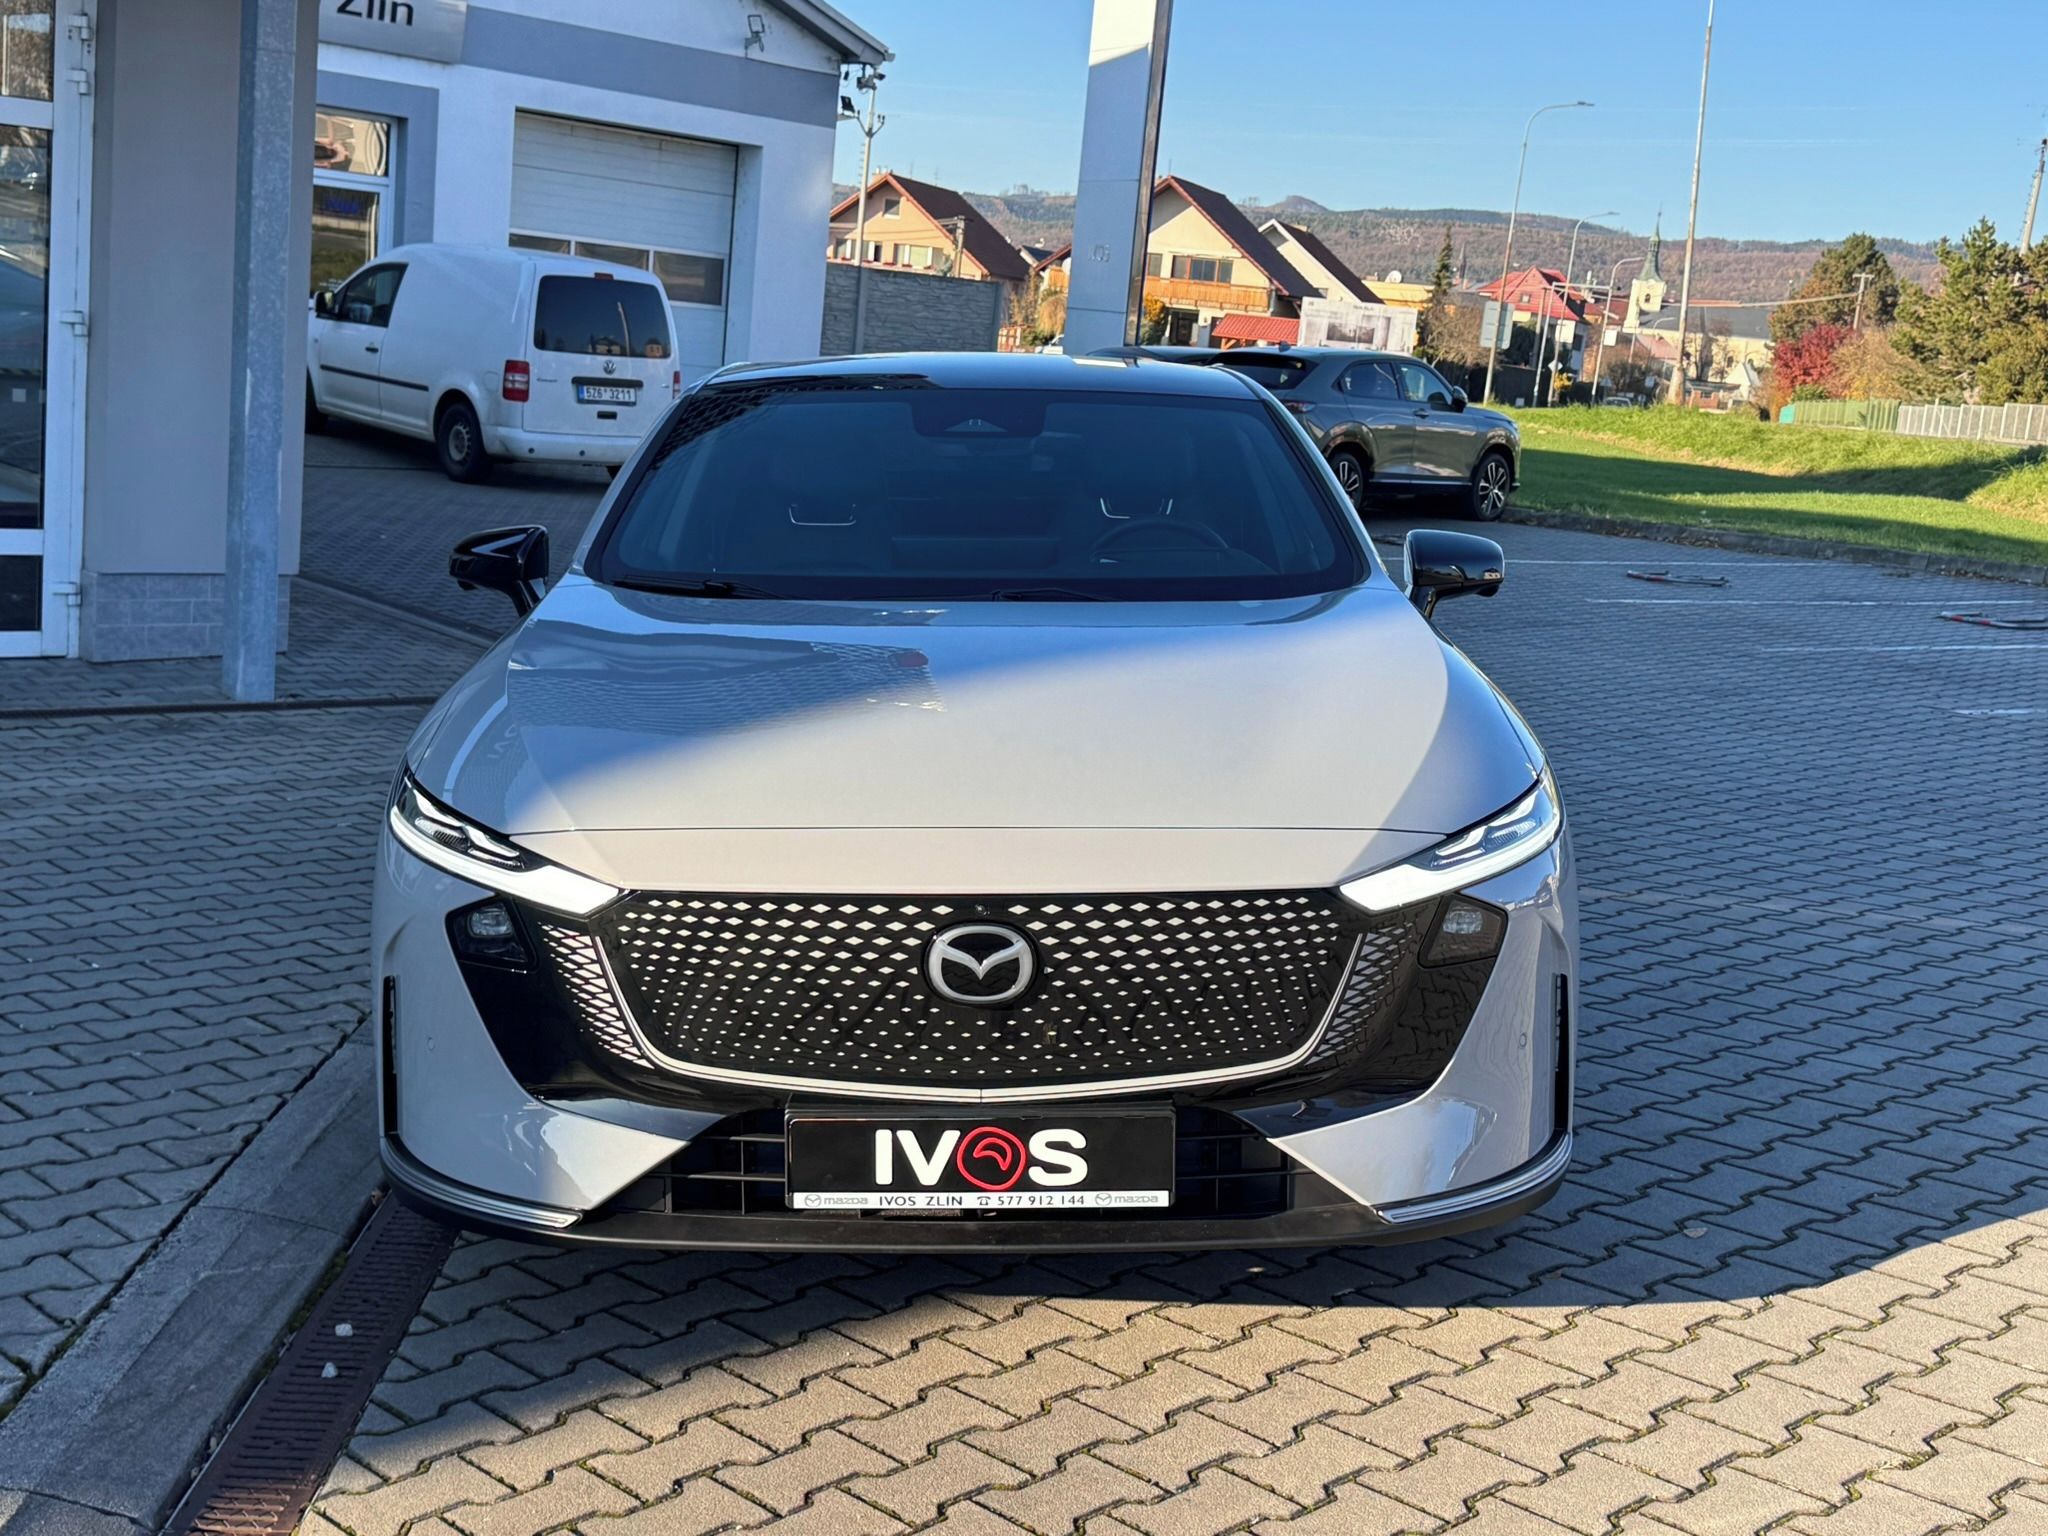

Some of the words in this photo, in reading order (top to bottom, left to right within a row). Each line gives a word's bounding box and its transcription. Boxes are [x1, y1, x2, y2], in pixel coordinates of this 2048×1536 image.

[586, 387, 603, 399] 5Z6
[609, 388, 632, 400] 3211
[879, 1196, 917, 1206] IVOS
[997, 1195, 1023, 1206] 577
[1028, 1195, 1054, 1206] 912
[1061, 1195, 1085, 1205] 144
